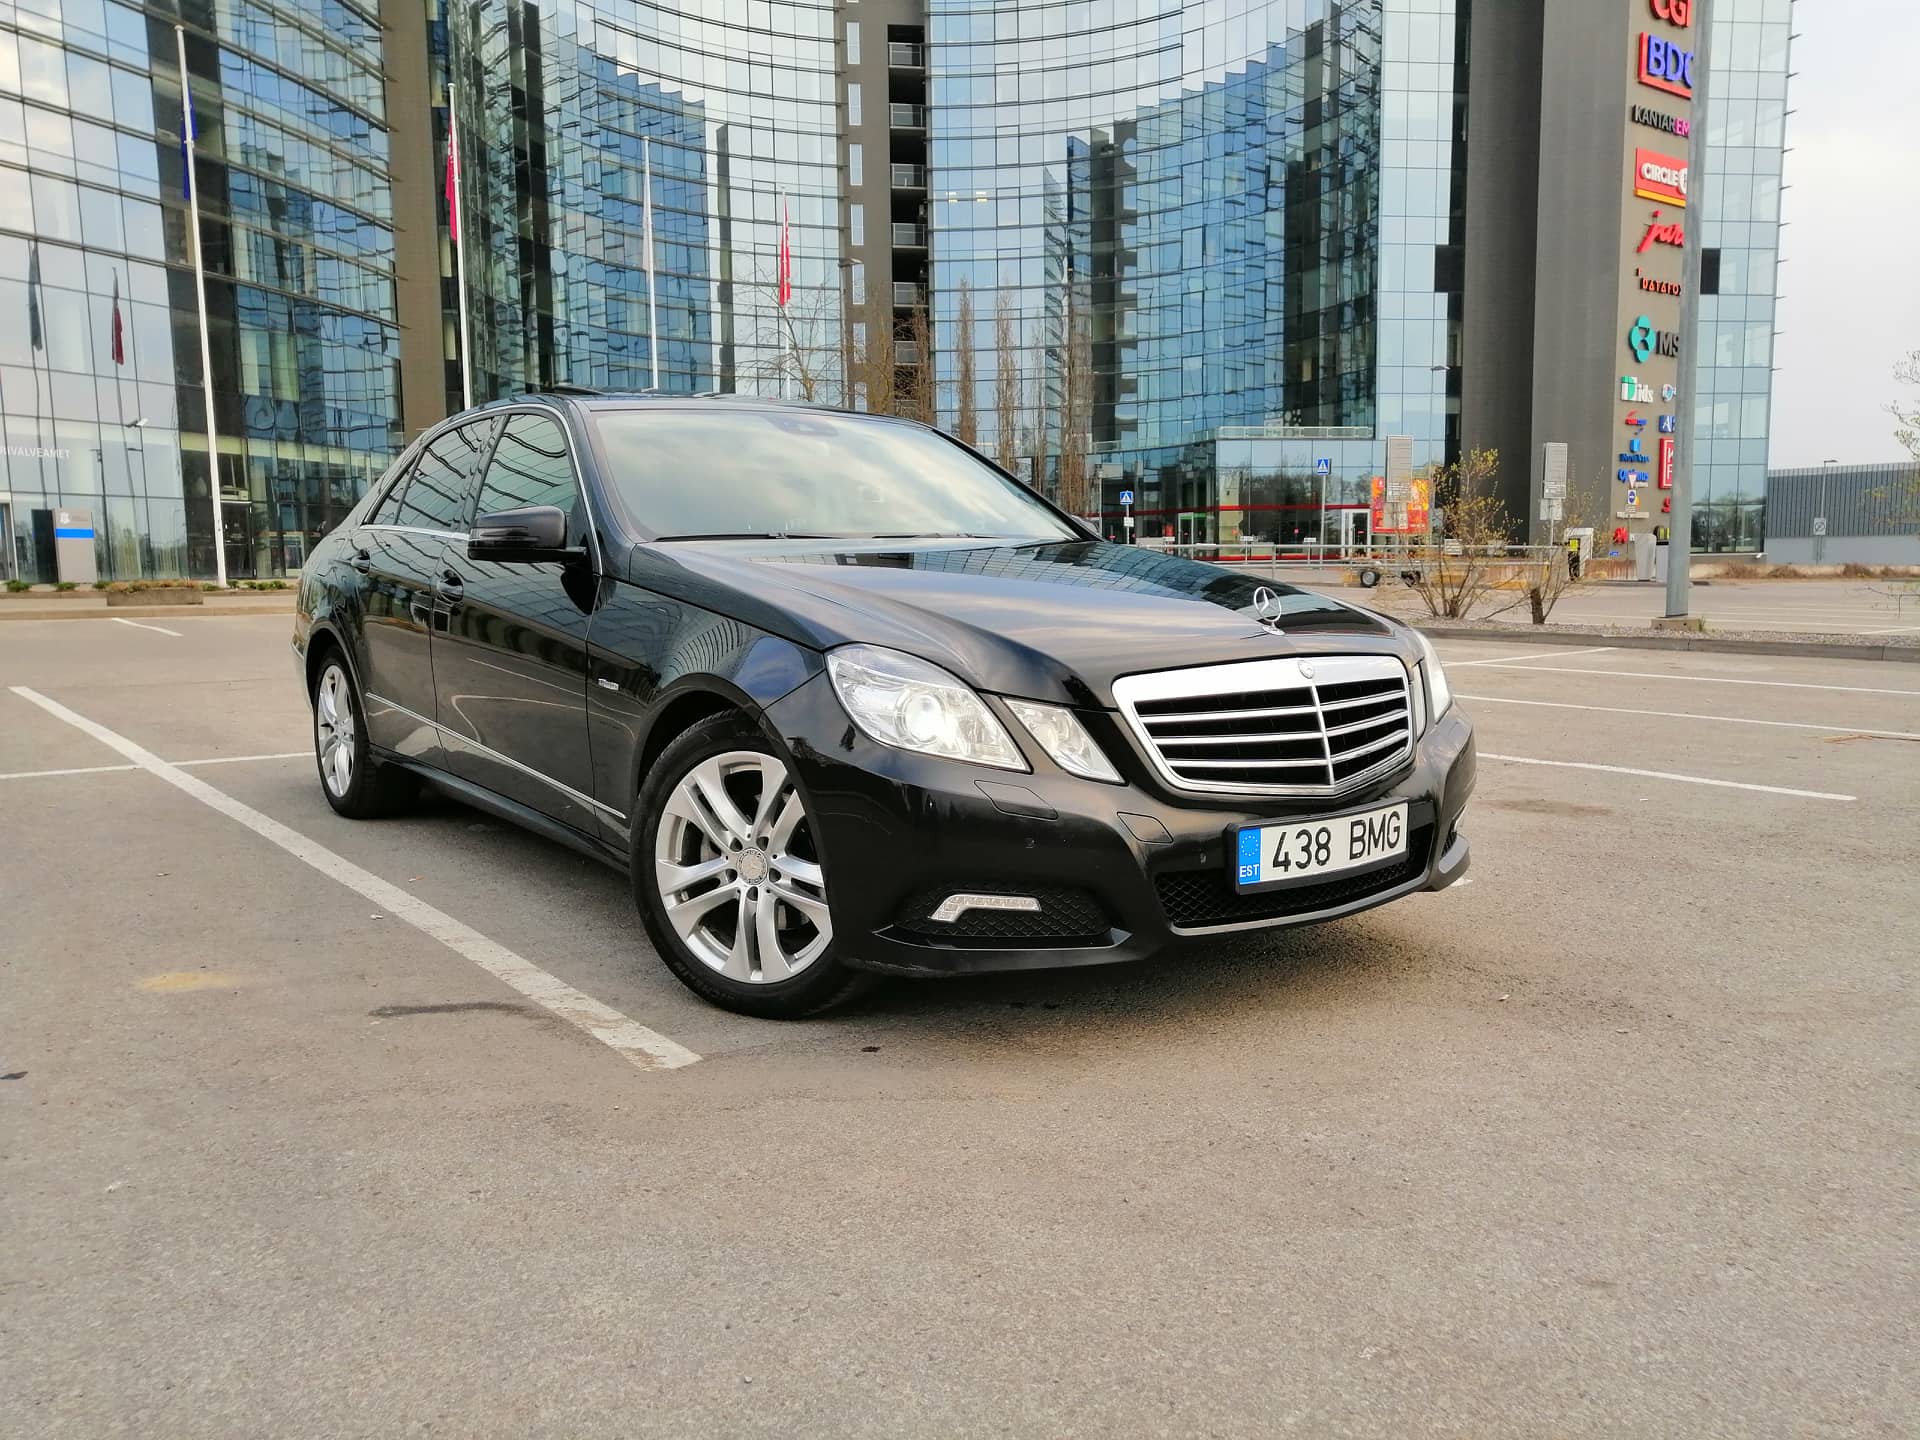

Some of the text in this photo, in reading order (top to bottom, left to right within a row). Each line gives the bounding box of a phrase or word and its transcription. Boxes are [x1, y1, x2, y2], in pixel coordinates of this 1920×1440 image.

[1272, 810, 1401, 873] 438 BMG
[1239, 863, 1260, 878] EST
